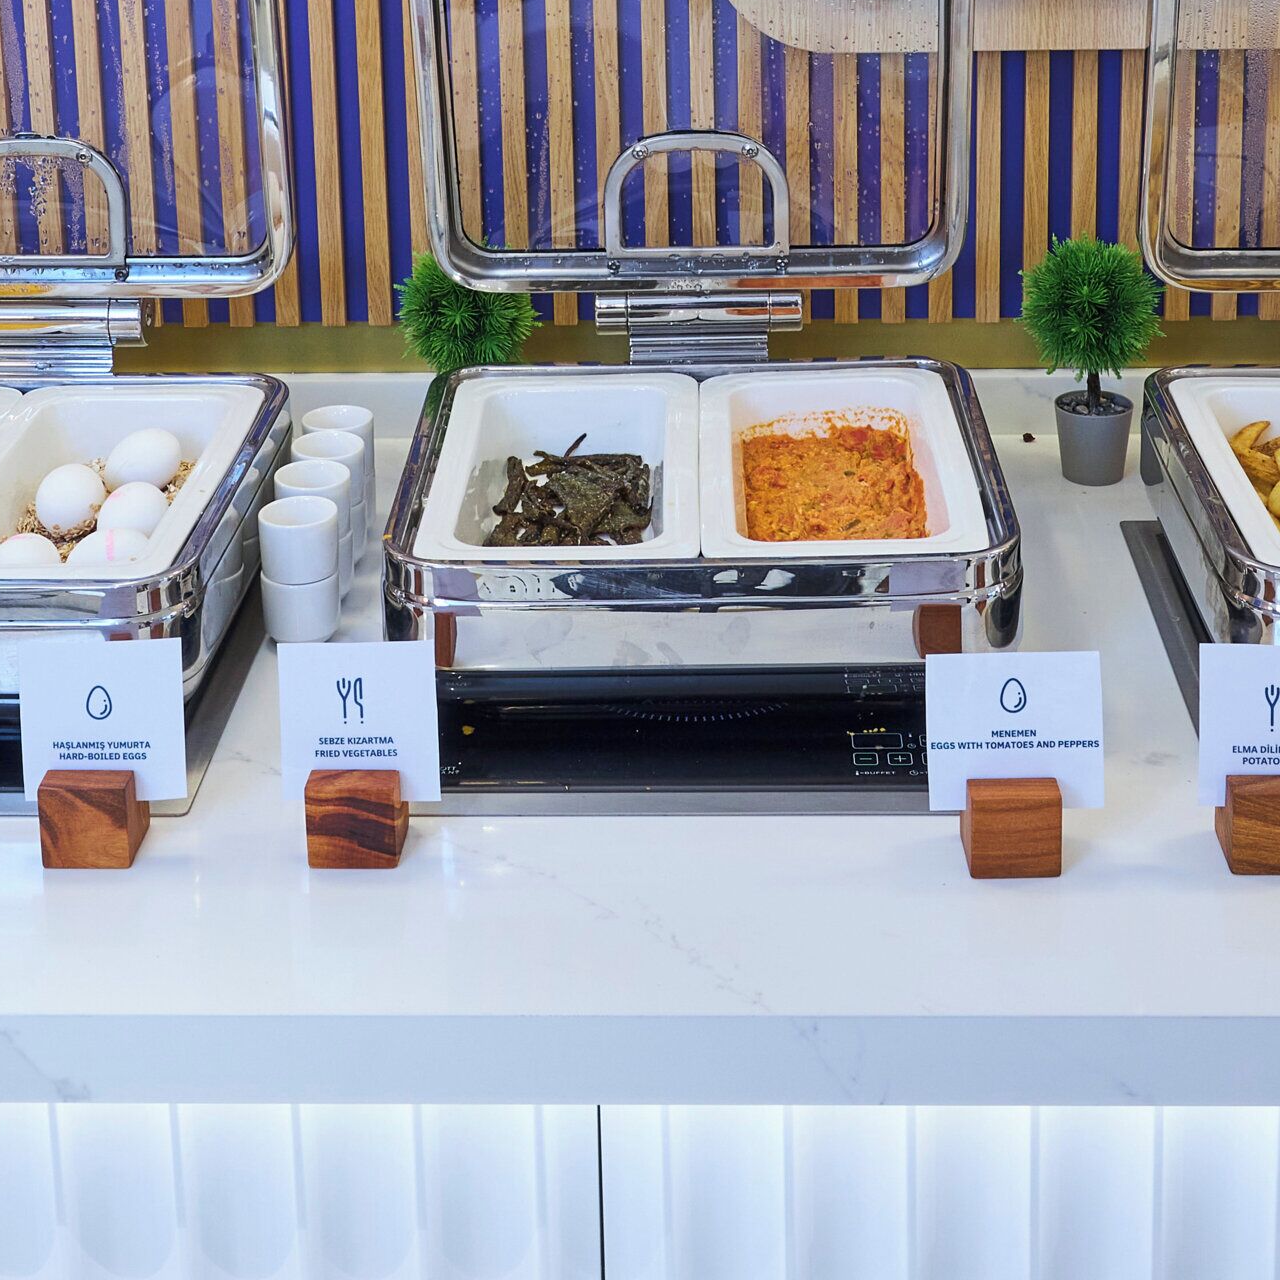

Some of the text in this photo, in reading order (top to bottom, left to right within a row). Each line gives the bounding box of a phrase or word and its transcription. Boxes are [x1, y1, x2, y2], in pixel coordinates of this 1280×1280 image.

[991, 729, 1037, 738] MENEMEN
[53, 741, 151, 750] HAŞLANMIŞ YUMURTA
[318, 736, 394, 746] SEBZE KIZARTMA
[930, 740, 1100, 750] EGGS WITH TOMATOES AND PEPPERS
[315, 749, 398, 758] FRIED VEGETABLES
[1232, 746, 1257, 755] ELMA
[60, 752, 147, 760] HARD-BOILED EGGS
[1242, 757, 1279, 766] POTATO
